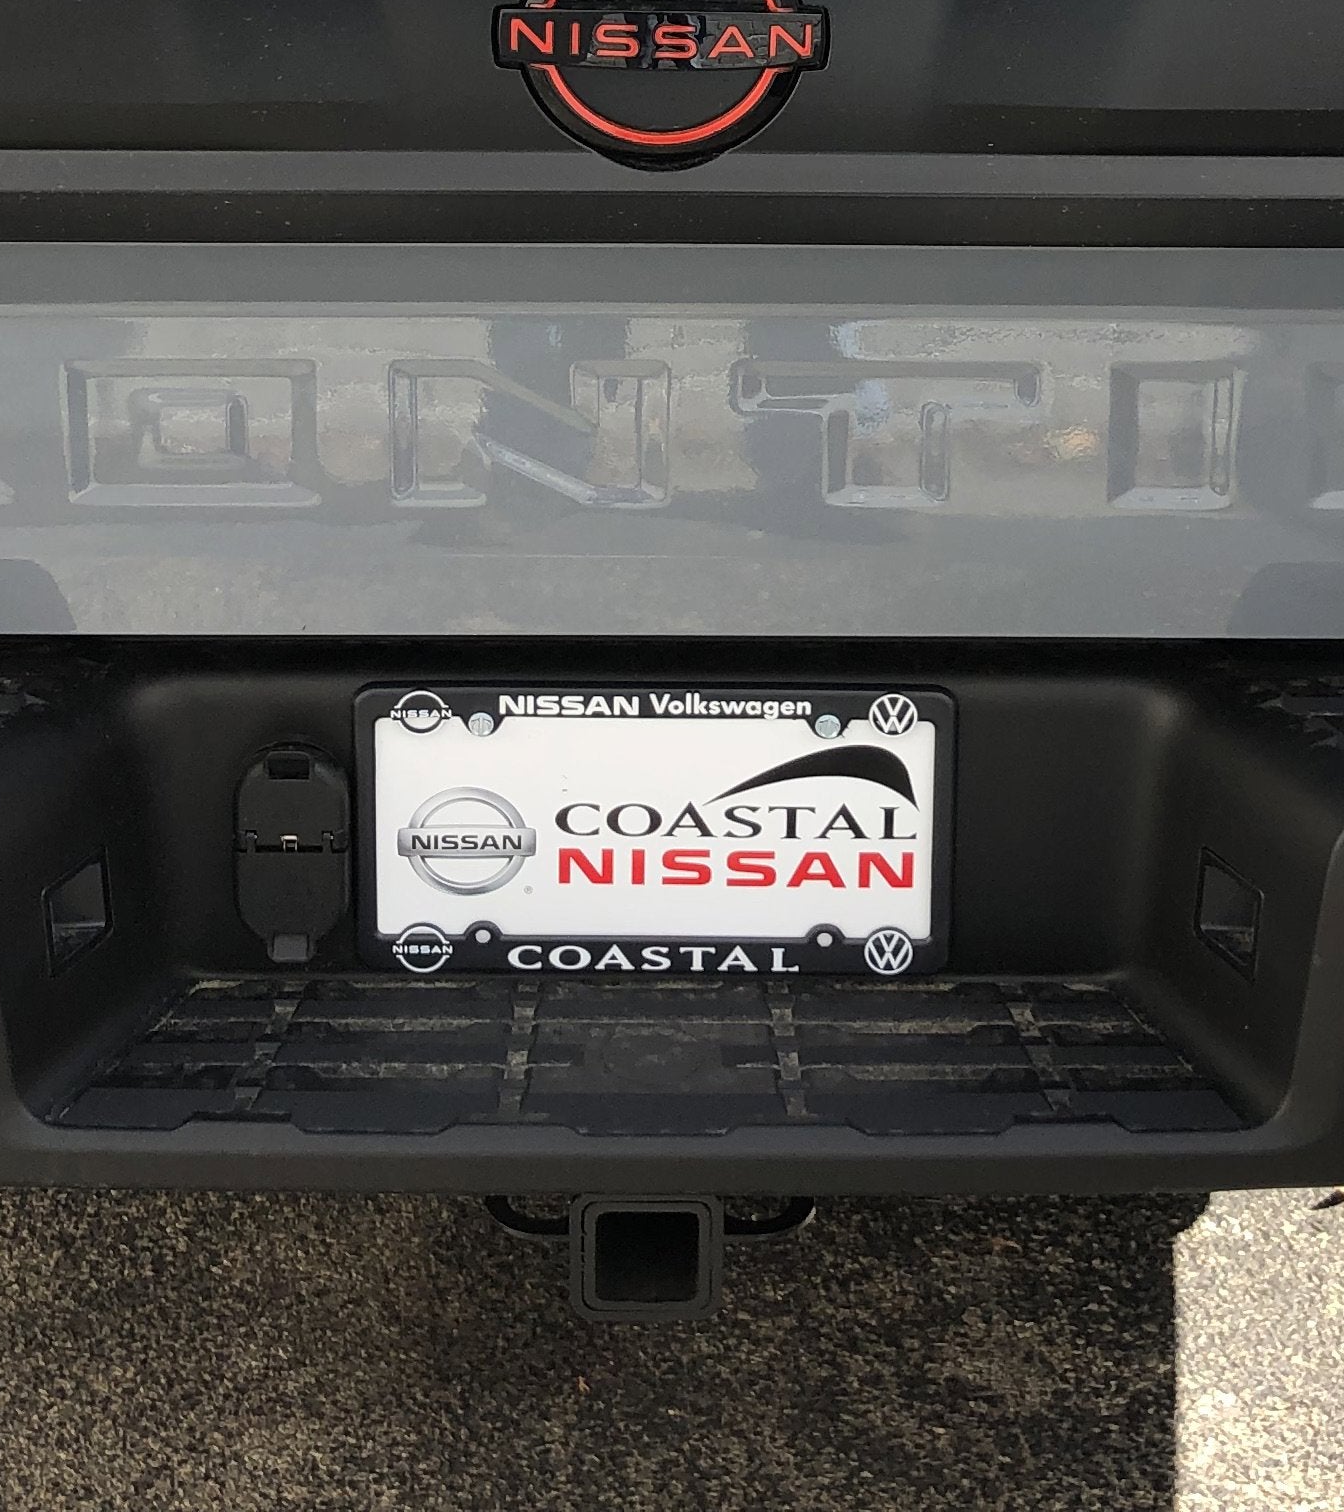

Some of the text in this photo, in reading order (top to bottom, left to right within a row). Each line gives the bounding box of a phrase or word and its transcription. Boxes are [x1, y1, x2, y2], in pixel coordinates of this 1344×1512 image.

[508, 17, 814, 60] NISSAN
[389, 706, 453, 721] NISSAN
[498, 693, 812, 720] NISSAN Volkswagen
[555, 800, 919, 841] COASTAL
[410, 833, 523, 852] NISSAN
[557, 847, 914, 889] NISSAN
[391, 942, 454, 957] NISSAN
[506, 944, 800, 973] COASTAL
